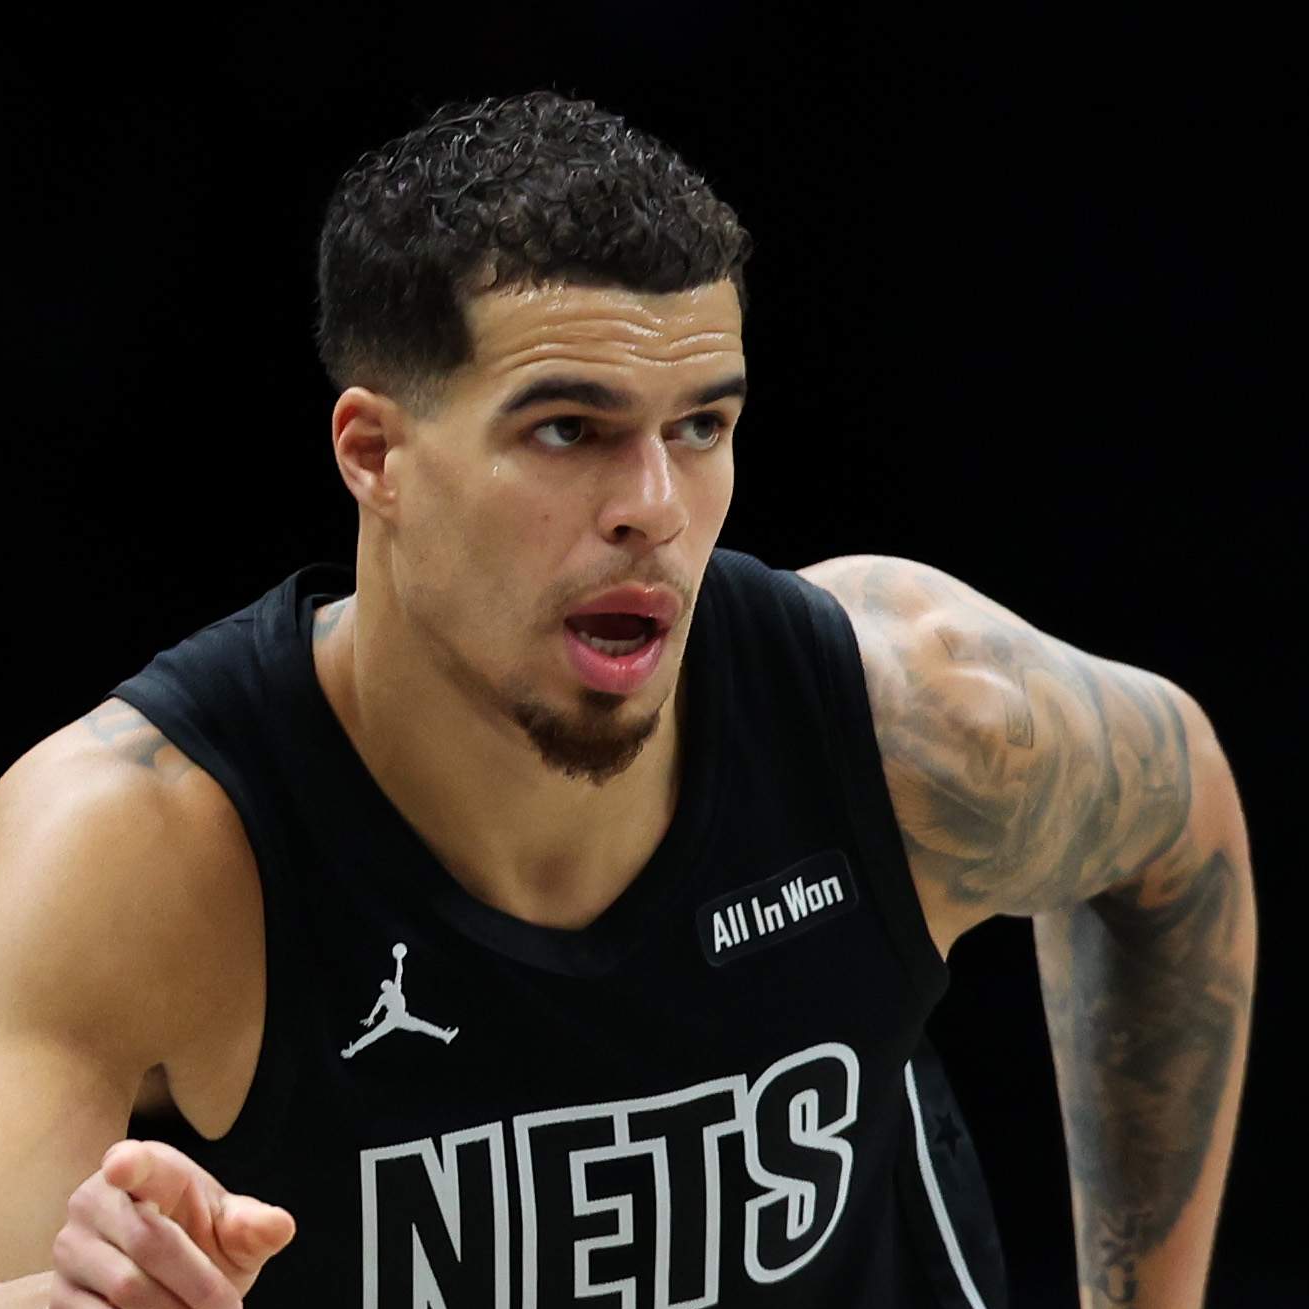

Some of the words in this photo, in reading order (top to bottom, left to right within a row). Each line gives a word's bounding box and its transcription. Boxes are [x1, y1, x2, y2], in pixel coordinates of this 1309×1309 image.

[713, 902, 750, 953] All
[751, 897, 785, 936] In
[780, 876, 844, 923] Won
